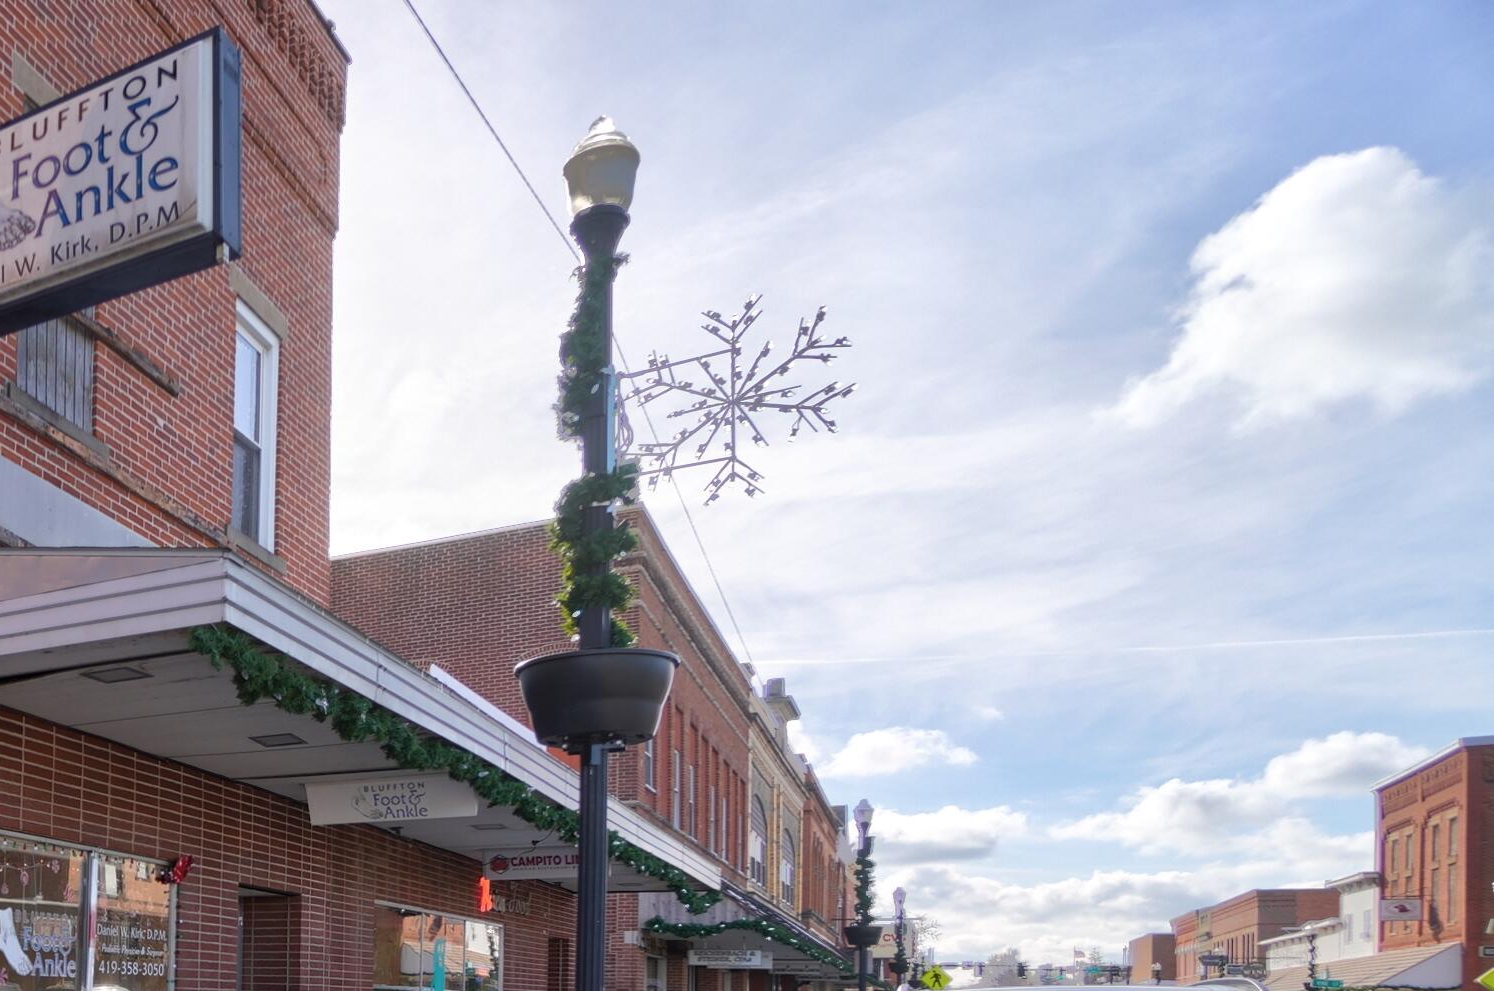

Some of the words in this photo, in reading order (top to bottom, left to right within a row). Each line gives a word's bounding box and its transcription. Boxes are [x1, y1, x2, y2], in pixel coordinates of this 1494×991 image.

[10, 125, 112, 201] Foot
[119, 95, 179, 156] &
[34, 154, 179, 239] Ankle
[14, 254, 40, 277] W.
[363, 782, 425, 793] BLUFFTON
[373, 793, 407, 806] Foot
[408, 789, 426, 805] &
[384, 804, 428, 819] Ankle
[511, 855, 561, 867] CAMPITO
[96, 923, 119, 937] Daniel
[30, 952, 77, 978] Ankle
[98, 960, 165, 977] 419-358-3050
